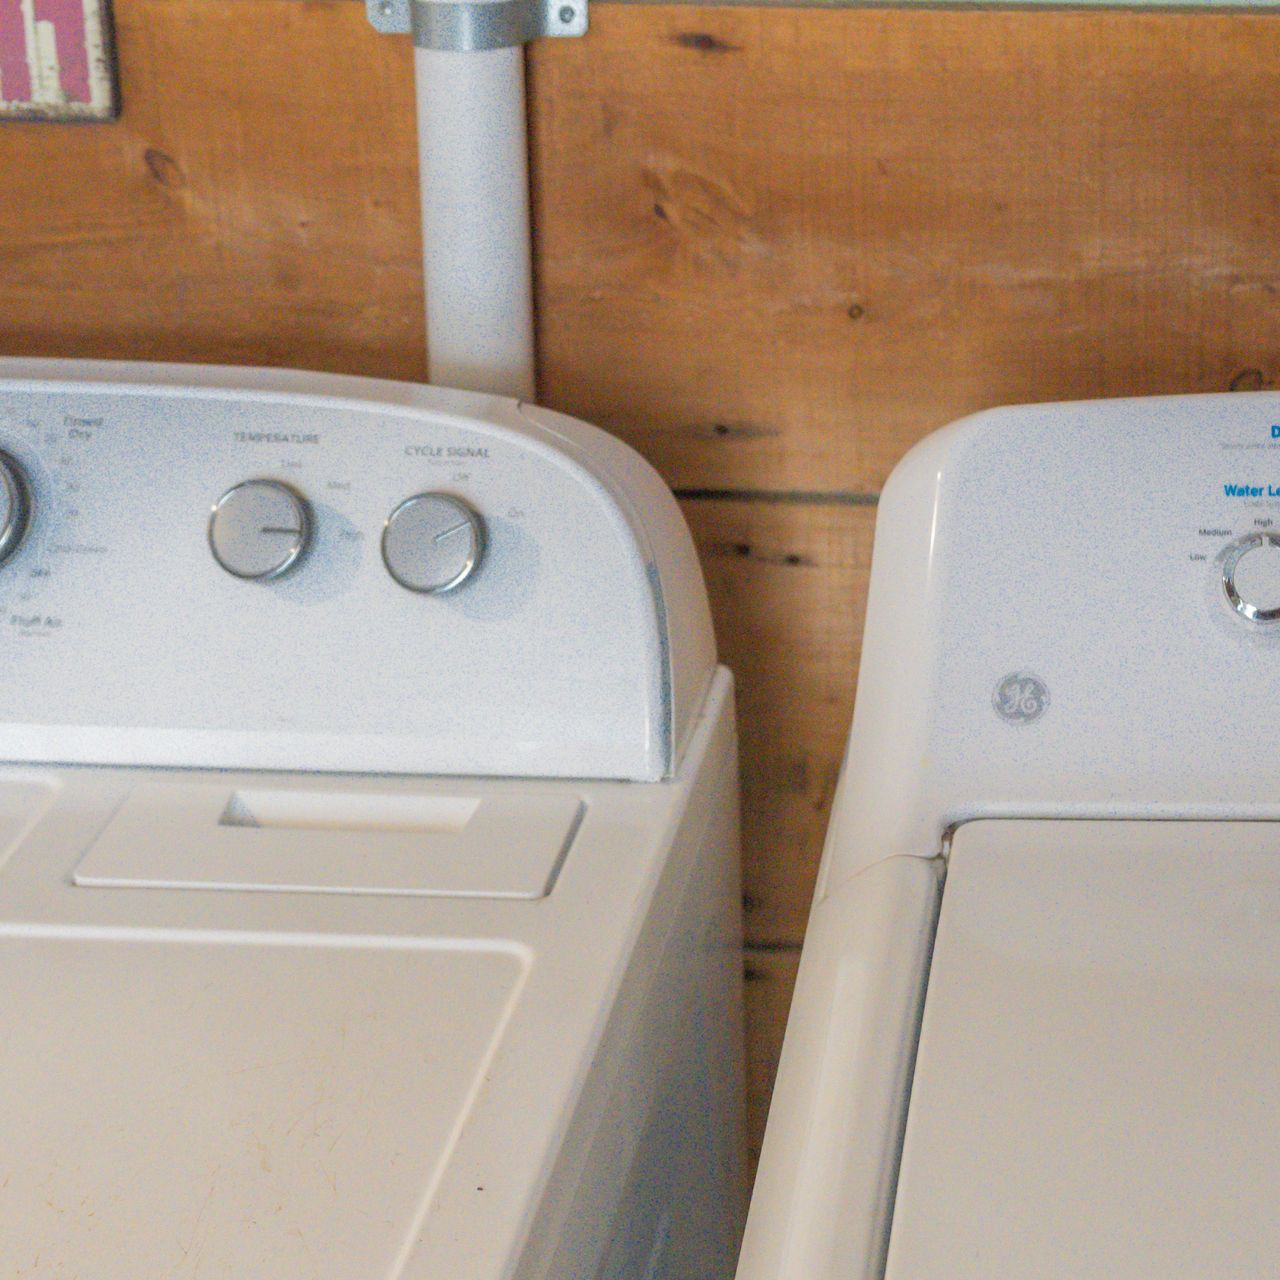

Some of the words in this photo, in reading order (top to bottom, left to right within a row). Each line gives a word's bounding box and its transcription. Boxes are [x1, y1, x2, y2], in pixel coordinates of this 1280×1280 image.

[233, 431, 320, 445] TEMPERATURE
[403, 445, 443, 457] CYCLE
[446, 447, 489, 458] SIGNAL
[1224, 485, 1264, 497] Water
[1253, 518, 1273, 529] High
[1198, 528, 1232, 538] Medium
[1189, 553, 1207, 562] Low
